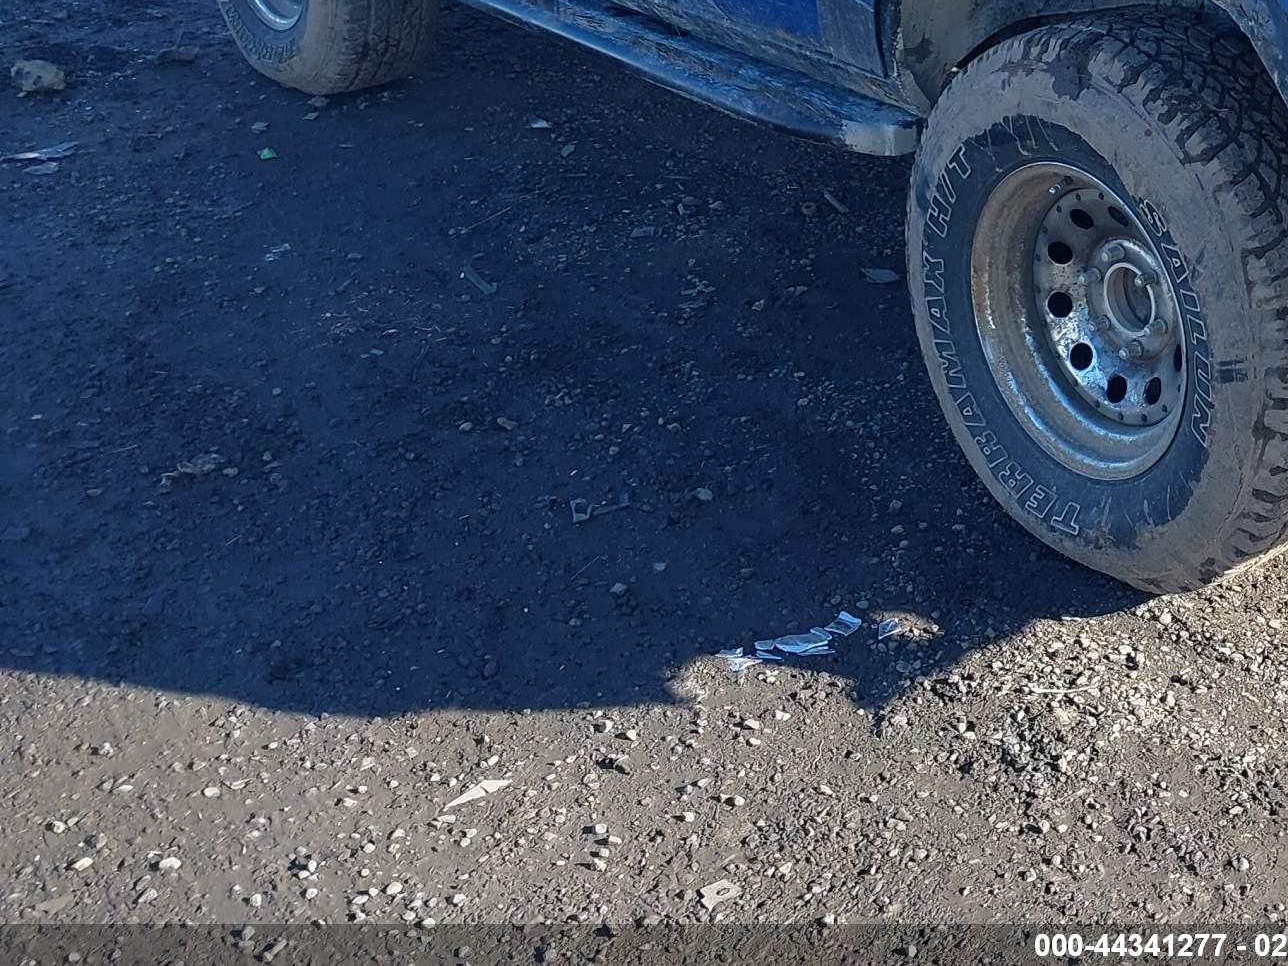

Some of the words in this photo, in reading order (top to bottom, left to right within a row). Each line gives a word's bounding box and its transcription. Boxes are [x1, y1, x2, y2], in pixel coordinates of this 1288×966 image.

[926, 145, 972, 238] H/T
[922, 249, 1081, 536] TERRAMAX
[1138, 199, 1214, 449] SAILUN
